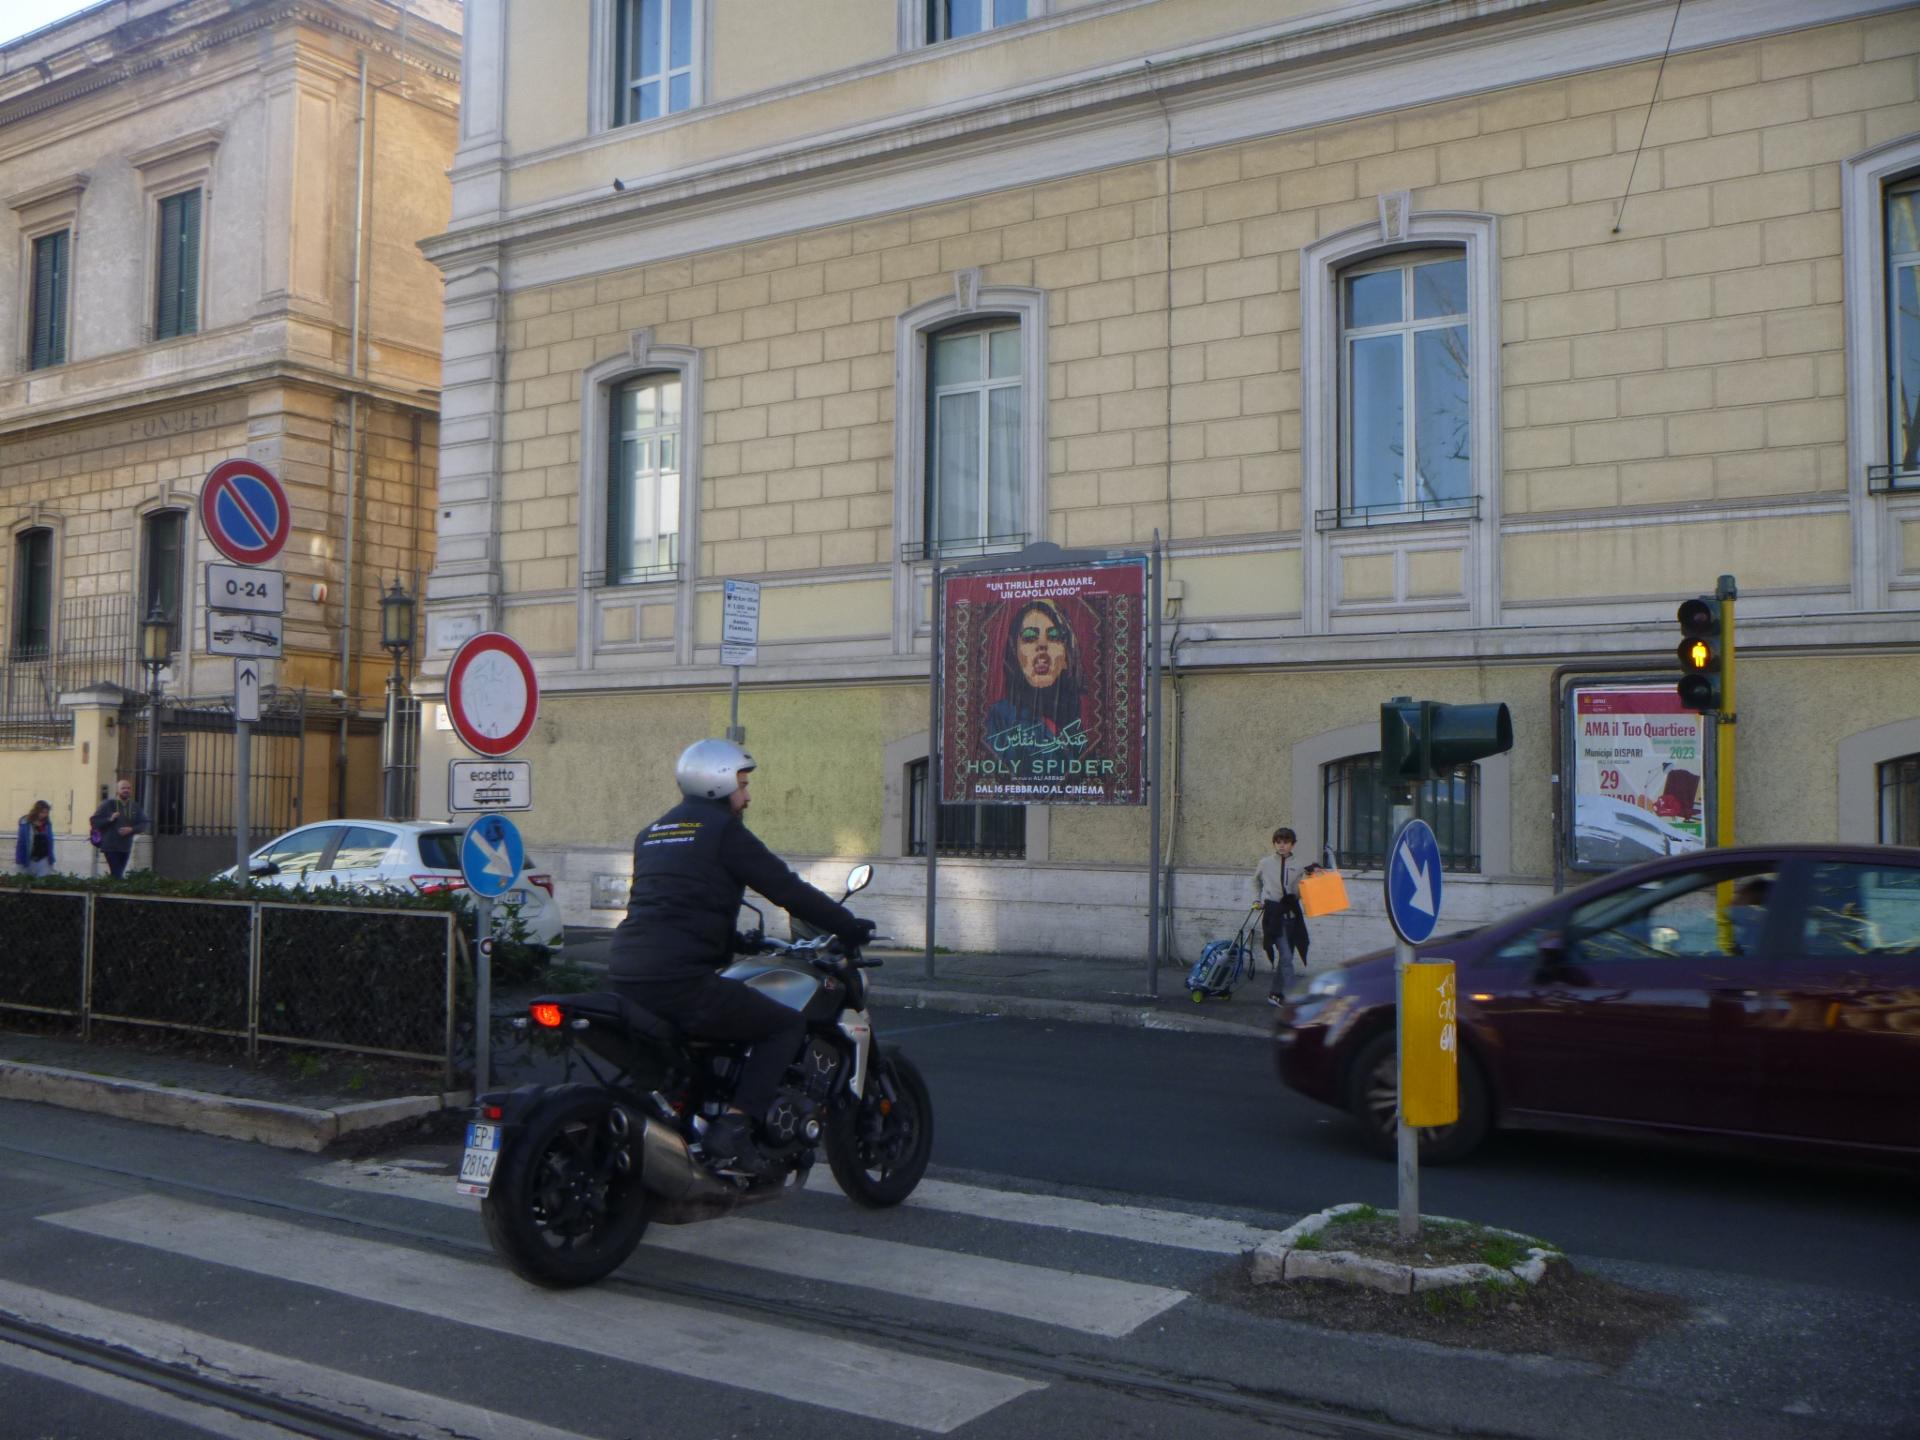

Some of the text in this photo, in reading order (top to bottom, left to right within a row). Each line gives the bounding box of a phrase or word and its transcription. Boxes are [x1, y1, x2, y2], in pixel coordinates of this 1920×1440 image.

[226, 579, 268, 598] 0-24
[1005, 580, 1045, 590] THRILLER
[1047, 579, 1060, 588] DA
[1061, 577, 1096, 587] AMARE,
[1001, 590, 1013, 599] UN
[1584, 722, 1696, 738] AMA il Tuo Quartiere
[1584, 748, 1643, 758] Municipi DISPARI
[1670, 746, 1695, 759] 2023
[966, 759, 1115, 775] HOLY SPIDER
[470, 769, 515, 782] eccetto
[1600, 769, 1619, 789] 29
[975, 784, 994, 793] DAL
[994, 784, 1003, 793] 16
[1004, 784, 1049, 794] FEBBRAIO
[1051, 784, 1064, 794] AL
[1065, 784, 1104, 795] CINEMA
[473, 1126, 489, 1147] EP
